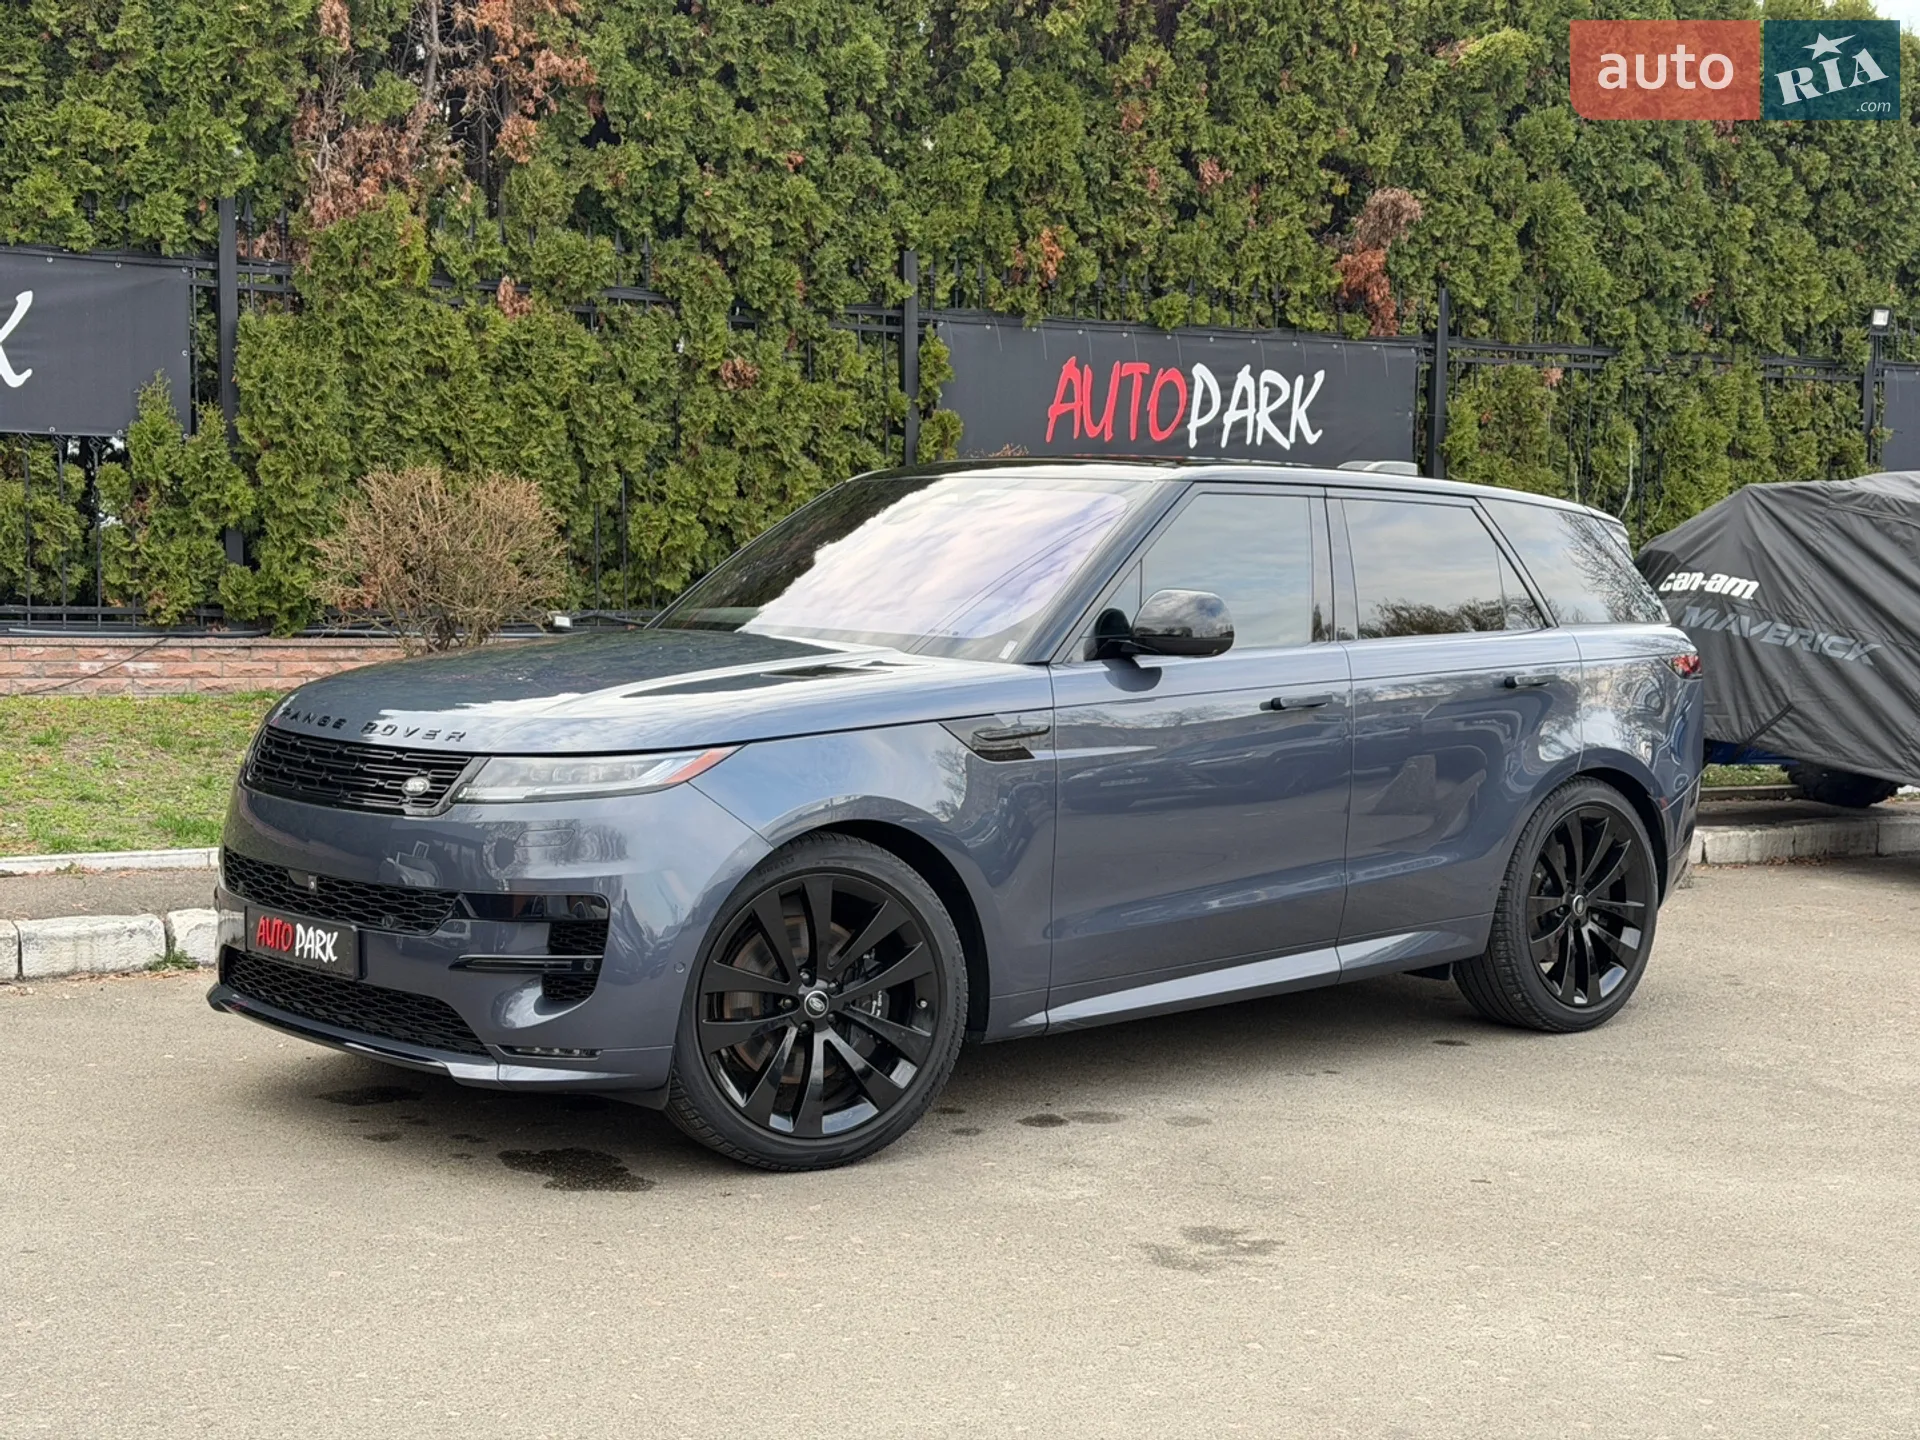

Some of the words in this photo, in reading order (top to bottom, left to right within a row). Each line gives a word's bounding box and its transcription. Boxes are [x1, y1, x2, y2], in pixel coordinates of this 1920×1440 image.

[1659, 571, 1760, 599] can-am
[1680, 605, 1882, 666] MAVERICK
[280, 706, 347, 730] RANGE
[361, 721, 466, 743] ROVER
